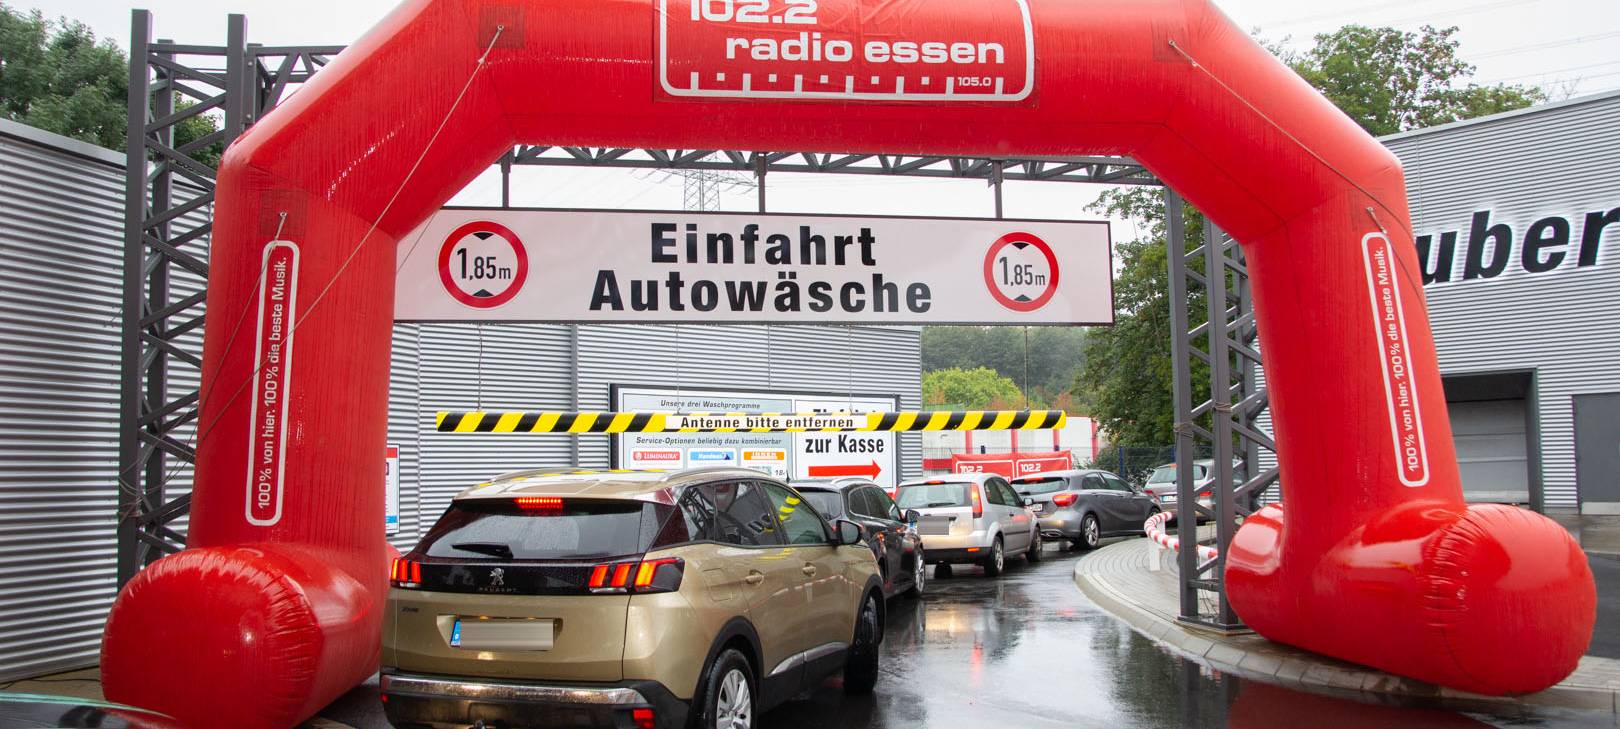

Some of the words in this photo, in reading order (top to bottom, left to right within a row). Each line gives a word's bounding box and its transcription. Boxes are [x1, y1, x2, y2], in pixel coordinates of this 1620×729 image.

[726, 31, 853, 63] radio
[864, 40, 1005, 64] essen
[957, 76, 992, 87] 105.0
[651, 222, 877, 267] Einfahrt
[1374, 246, 1389, 285] Musik.
[271, 256, 287, 301] Musik.
[589, 269, 932, 314] Autowäsche
[1382, 287, 1395, 321] beste
[268, 303, 283, 341] beste
[1387, 323, 1398, 340] die
[267, 344, 280, 363] die
[660, 399, 685, 408] Unsere
[687, 400, 701, 408] drei
[703, 401, 761, 410] Waschprogramme
[1397, 381, 1409, 407] hier.
[262, 408, 276, 438] hier.
[680, 416, 740, 428] Antenne
[746, 417, 779, 428] bitte
[785, 417, 854, 428] entfernen
[1402, 409, 1414, 431] von
[636, 436, 696, 446] Service-Optionen
[698, 437, 723, 446] beliebig
[805, 438, 832, 453] zur
[838, 434, 884, 453] Kasse
[263, 441, 274, 464] von
[960, 465, 984, 473] 102.2
[1020, 463, 1041, 472] 102.2
